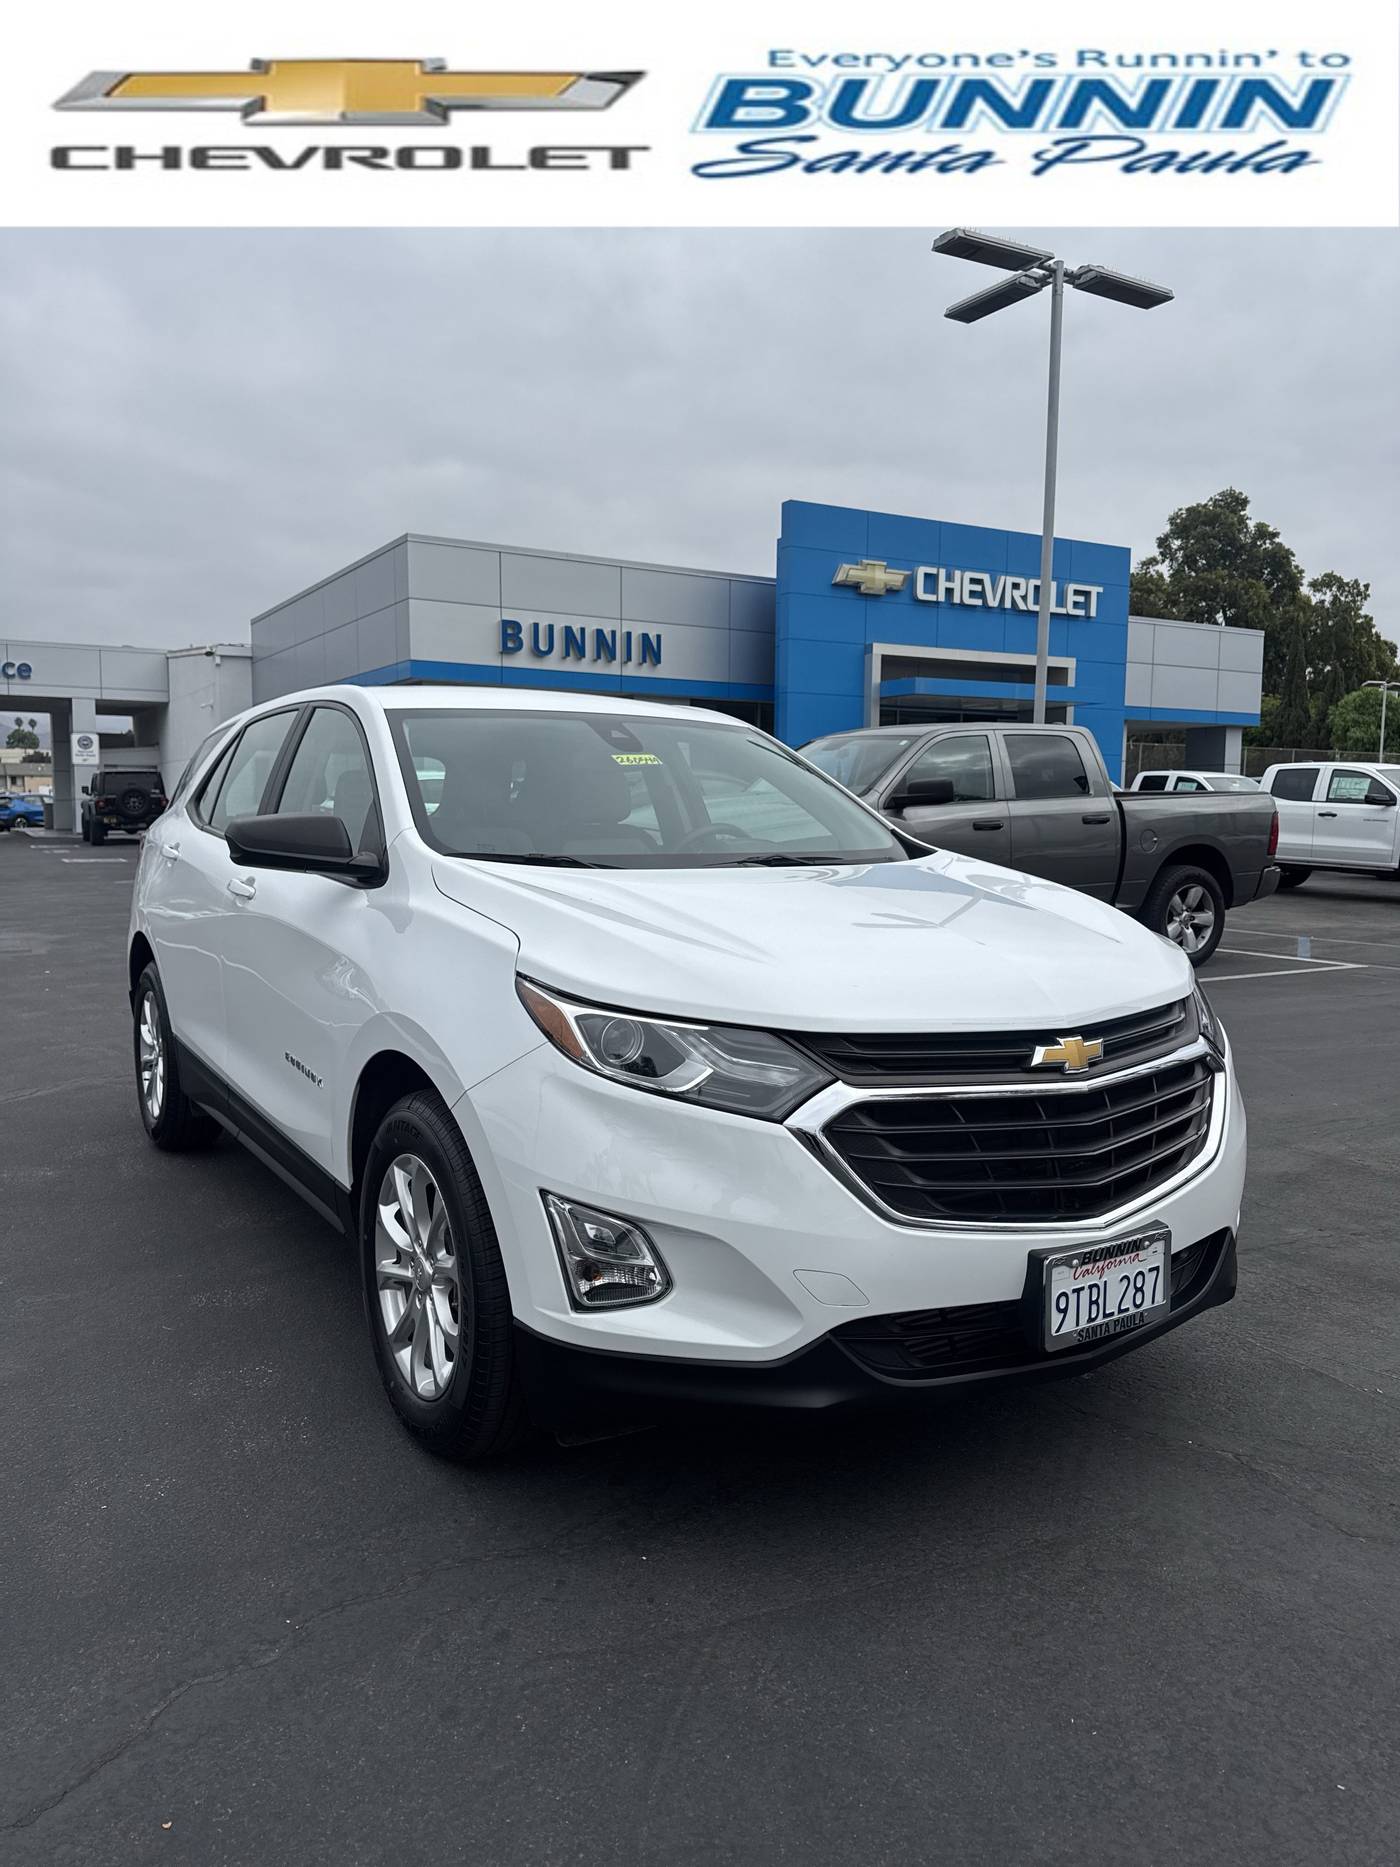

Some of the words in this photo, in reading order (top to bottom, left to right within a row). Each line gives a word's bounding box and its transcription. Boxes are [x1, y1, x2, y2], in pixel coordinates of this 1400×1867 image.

[915, 565, 1104, 618] CHEVROLET
[499, 618, 663, 666] BUNNIN
[1072, 1252, 1148, 1281] California
[1081, 1237, 1143, 1266] BUNNIN
[1055, 1265, 1160, 1334] 9TBL287
[1077, 1321, 1111, 1343] SANTA
[1113, 1311, 1145, 1335] PAULA
